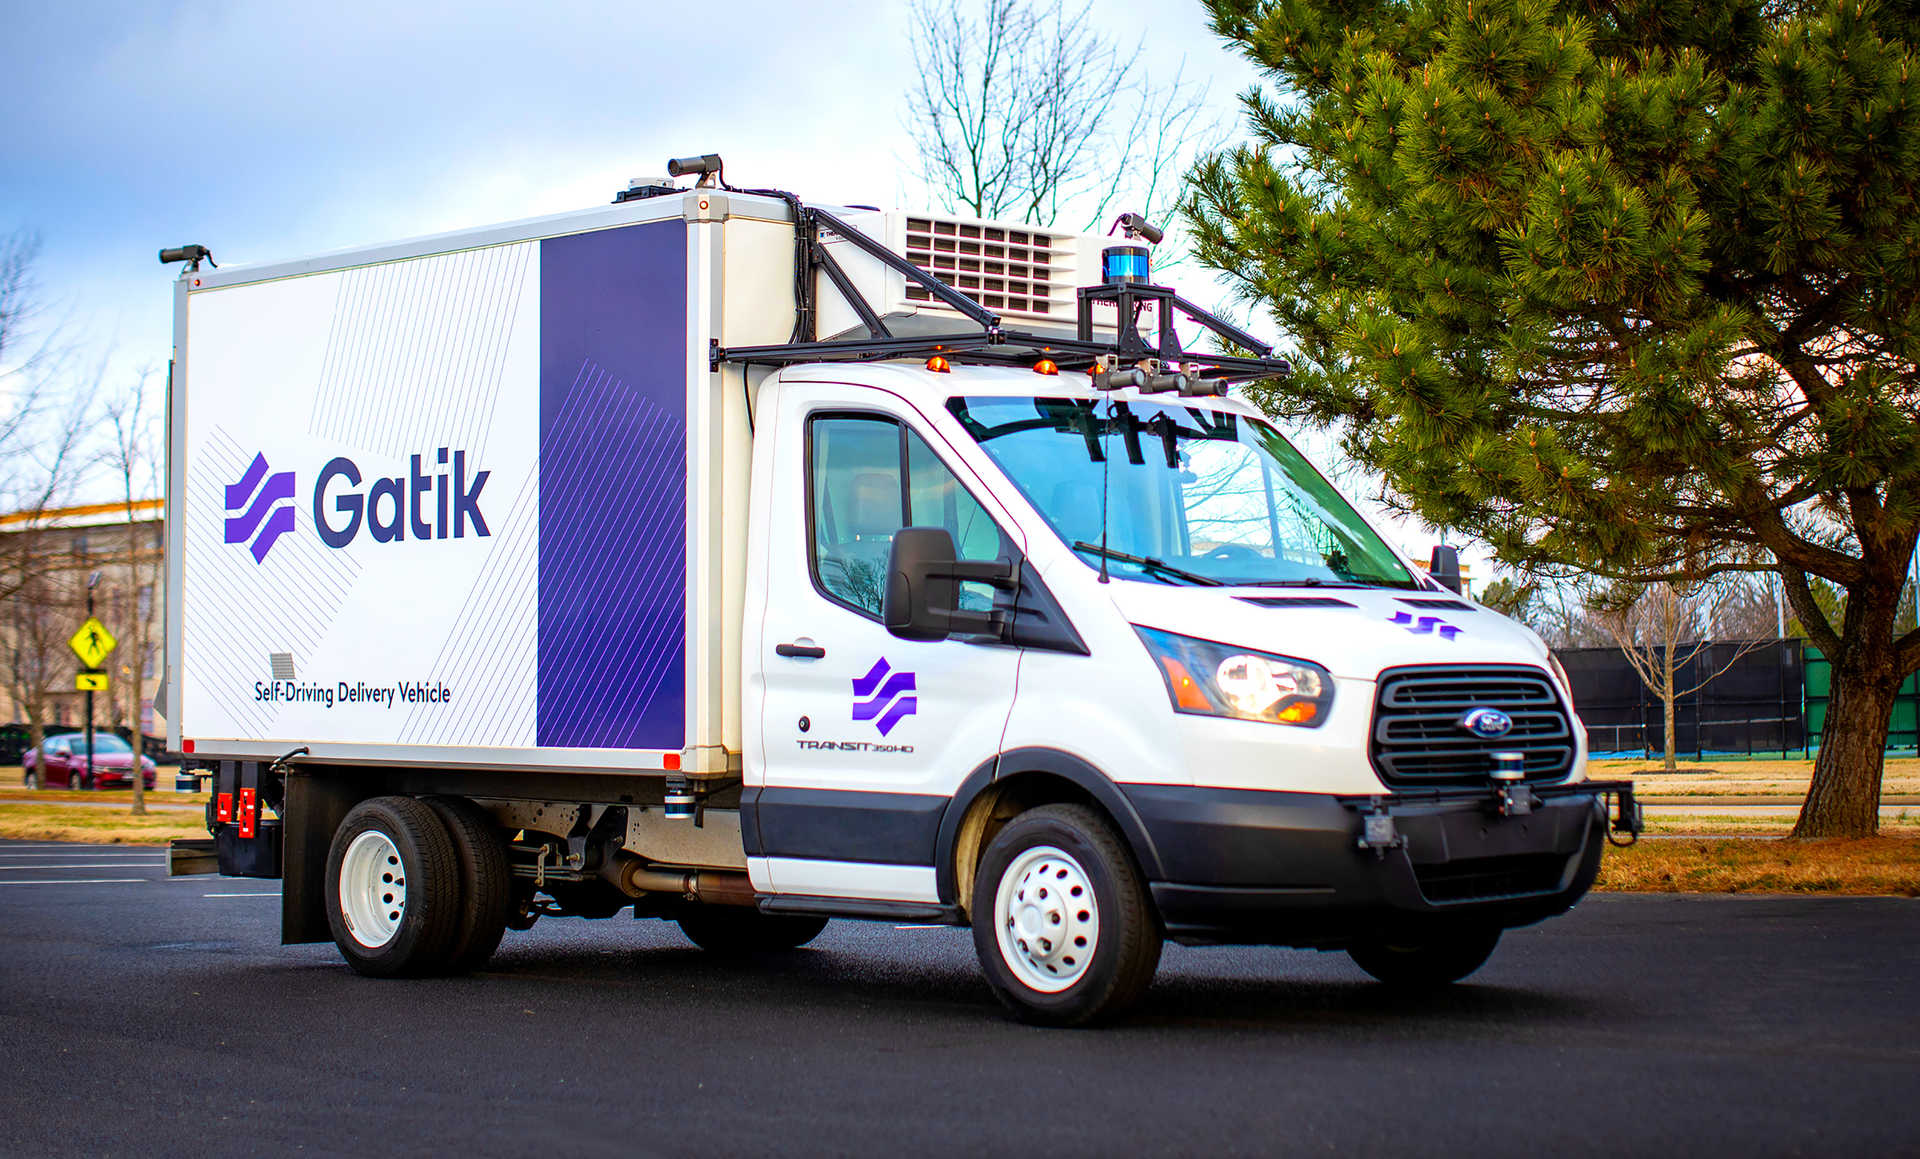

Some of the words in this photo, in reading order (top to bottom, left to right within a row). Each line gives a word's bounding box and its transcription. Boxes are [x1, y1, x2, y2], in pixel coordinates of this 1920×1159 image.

[313, 446, 492, 549] Gatik
[254, 681, 334, 708] Self-Driving
[338, 681, 396, 709] Delivery
[398, 681, 451, 703] Vehicle
[1480, 713, 1506, 732] Ford
